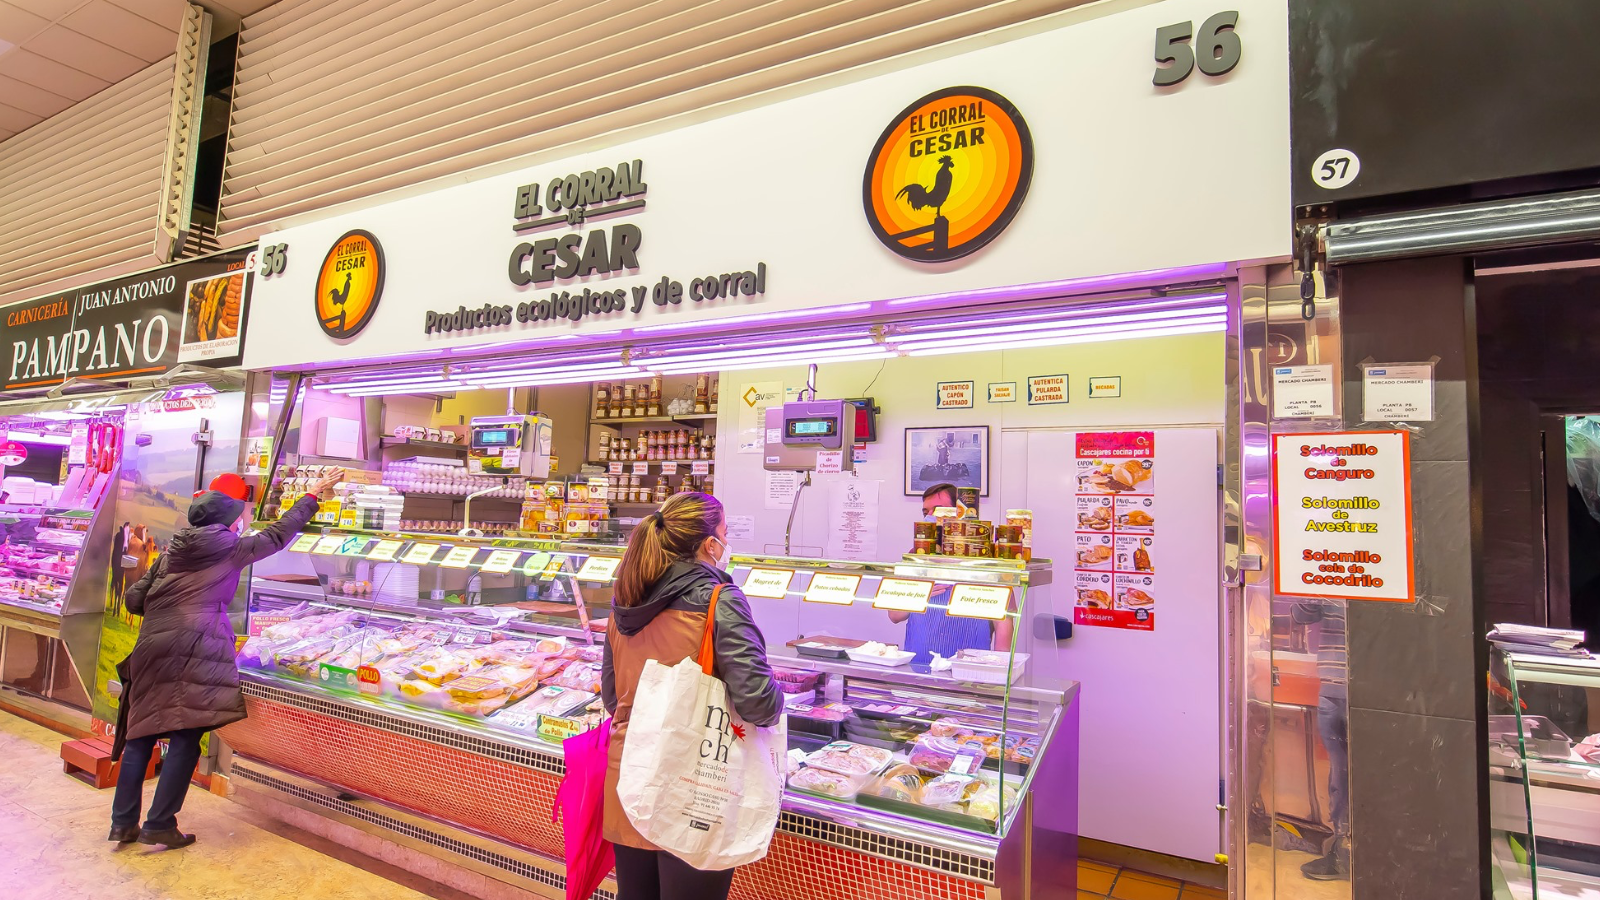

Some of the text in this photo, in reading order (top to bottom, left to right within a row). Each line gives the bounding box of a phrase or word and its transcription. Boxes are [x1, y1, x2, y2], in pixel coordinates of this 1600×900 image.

[1152, 10, 1242, 87] 56
[910, 101, 985, 134] EL CORRAL
[909, 126, 985, 158] CESAR
[1320, 156, 1351, 181] 57
[514, 159, 648, 219] EL CORRAL
[567, 207, 584, 225] DE
[336, 240, 367, 257] EL CORRAL
[508, 223, 642, 286] CESAR
[226, 261, 245, 272] LOCAL
[260, 242, 289, 277] 56
[335, 256, 366, 273] CESAR
[78, 275, 176, 316] JUAN ANTONIO
[424, 261, 767, 335] Productos ecológicos y de corral
[7, 297, 69, 327] CARNICERÍA
[8, 314, 170, 380] PAMPANO
[1033, 378, 1064, 386] AUTENTICA
[1035, 386, 1062, 394] PULARDA
[941, 399, 968, 407] CASTRADO
[1034, 393, 1063, 402] CASTRADA
[1080, 448, 1111, 457] Cascajares
[1112, 448, 1132, 456] cocina
[1133, 449, 1144, 457] por
[1300, 443, 1378, 457] Solomillo
[1330, 456, 1347, 467] de
[1303, 467, 1375, 481] Canguro
[1301, 496, 1380, 510] Solomillo
[1332, 509, 1349, 520] de
[1305, 519, 1378, 533] Avestruz
[1302, 549, 1382, 564] Solomillo
[1318, 562, 1365, 574] cola de
[752, 578, 773, 586] Magret
[1301, 572, 1384, 588] Cocodrilo
[914, 591, 926, 599] foie
[975, 596, 999, 605] fresco
[359, 668, 379, 682] POLLO
[704, 705, 732, 737] m
[551, 727, 563, 737] Pollo
